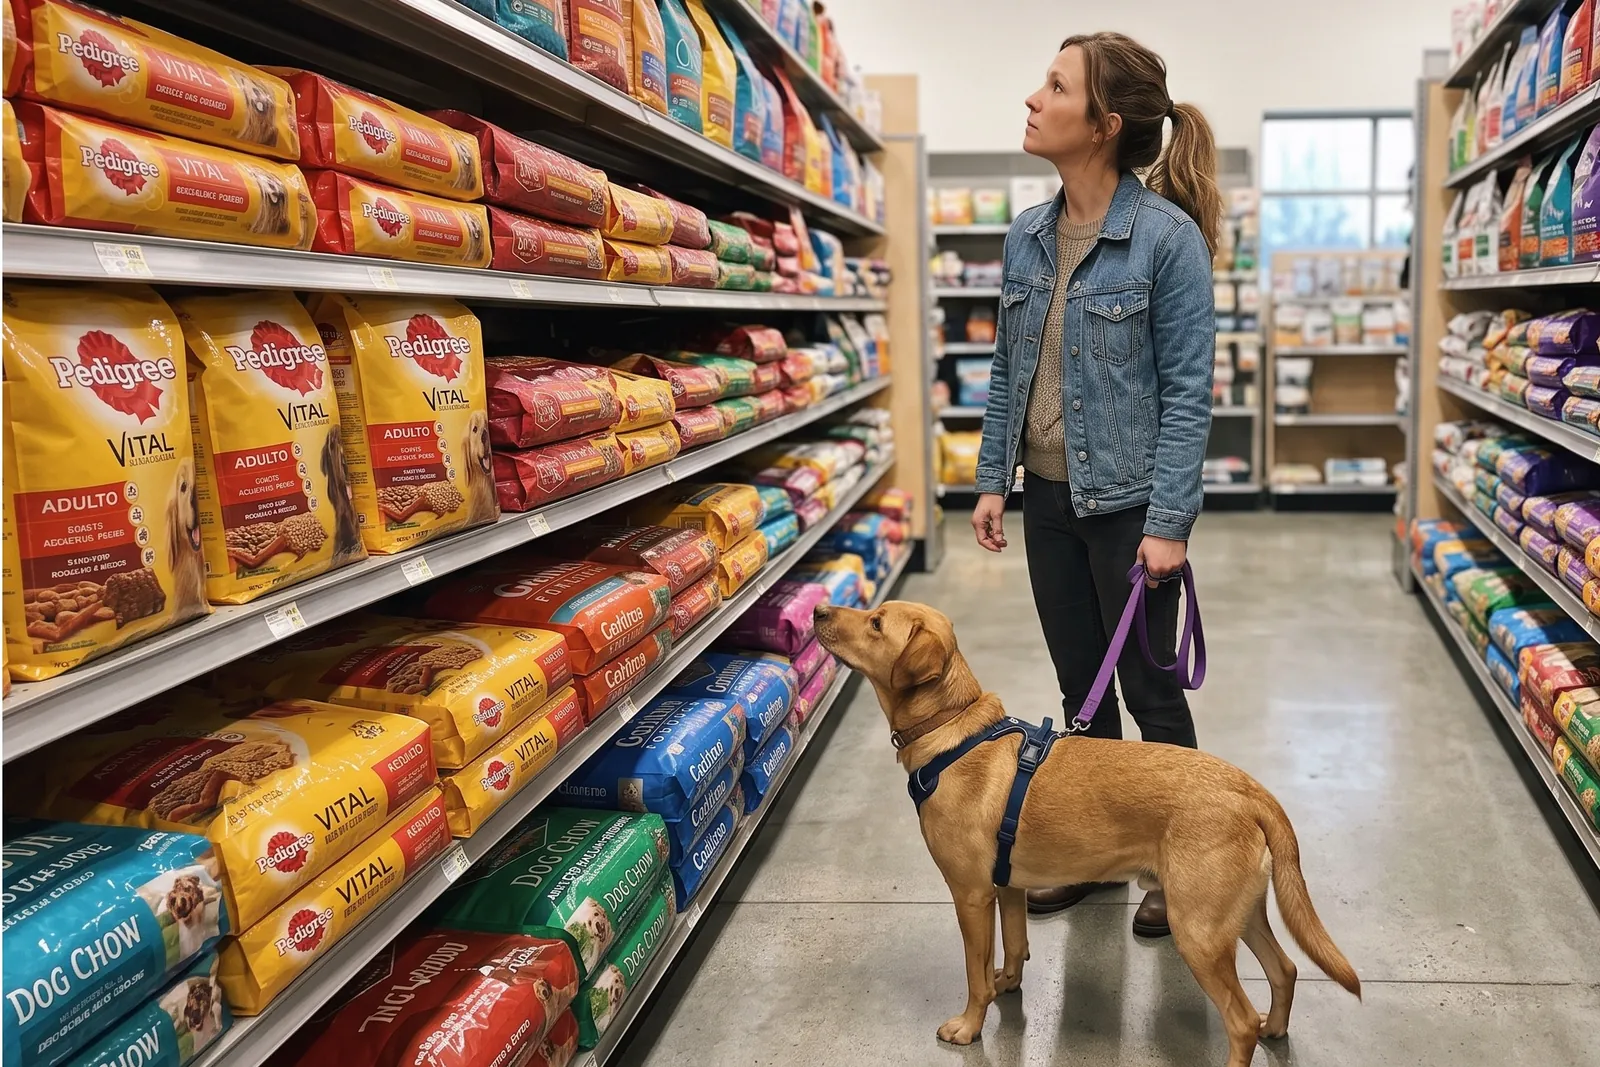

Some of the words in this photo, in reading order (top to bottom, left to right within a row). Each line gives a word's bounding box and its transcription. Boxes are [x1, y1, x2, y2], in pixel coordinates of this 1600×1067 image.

[57, 32, 140, 73] Pedigree
[157, 55, 212, 87] VITAL
[348, 115, 397, 142] Pedigree
[80, 145, 159, 177] Pedigree
[176, 156, 230, 182] VITAL
[362, 202, 410, 224] Pedigree
[224, 343, 326, 372] Pedigree
[384, 334, 470, 359] Pedigree
[48, 356, 176, 390] Pedigree
[422, 387, 470, 412] VITAL
[277, 402, 329, 431] VITAL
[384, 426, 430, 440] ADULTO
[107, 431, 174, 468] VITAL
[234, 450, 288, 470] ADULTO
[42, 491, 118, 514] ADULTO
[504, 673, 540, 701] VITAL
[514, 731, 550, 762] VITAL
[314, 786, 376, 832] VITAL
[254, 831, 316, 876] Pedigree
[510, 856, 559, 888] DOG
[547, 818, 600, 859] CHOW
[335, 855, 394, 905] VITAL
[603, 879, 630, 913] DOG
[630, 848, 654, 890] CHOW
[276, 907, 334, 957] Pedigree
[6, 966, 71, 1026] DOG
[70, 915, 142, 980] CHOW
[622, 942, 646, 977] DOG
